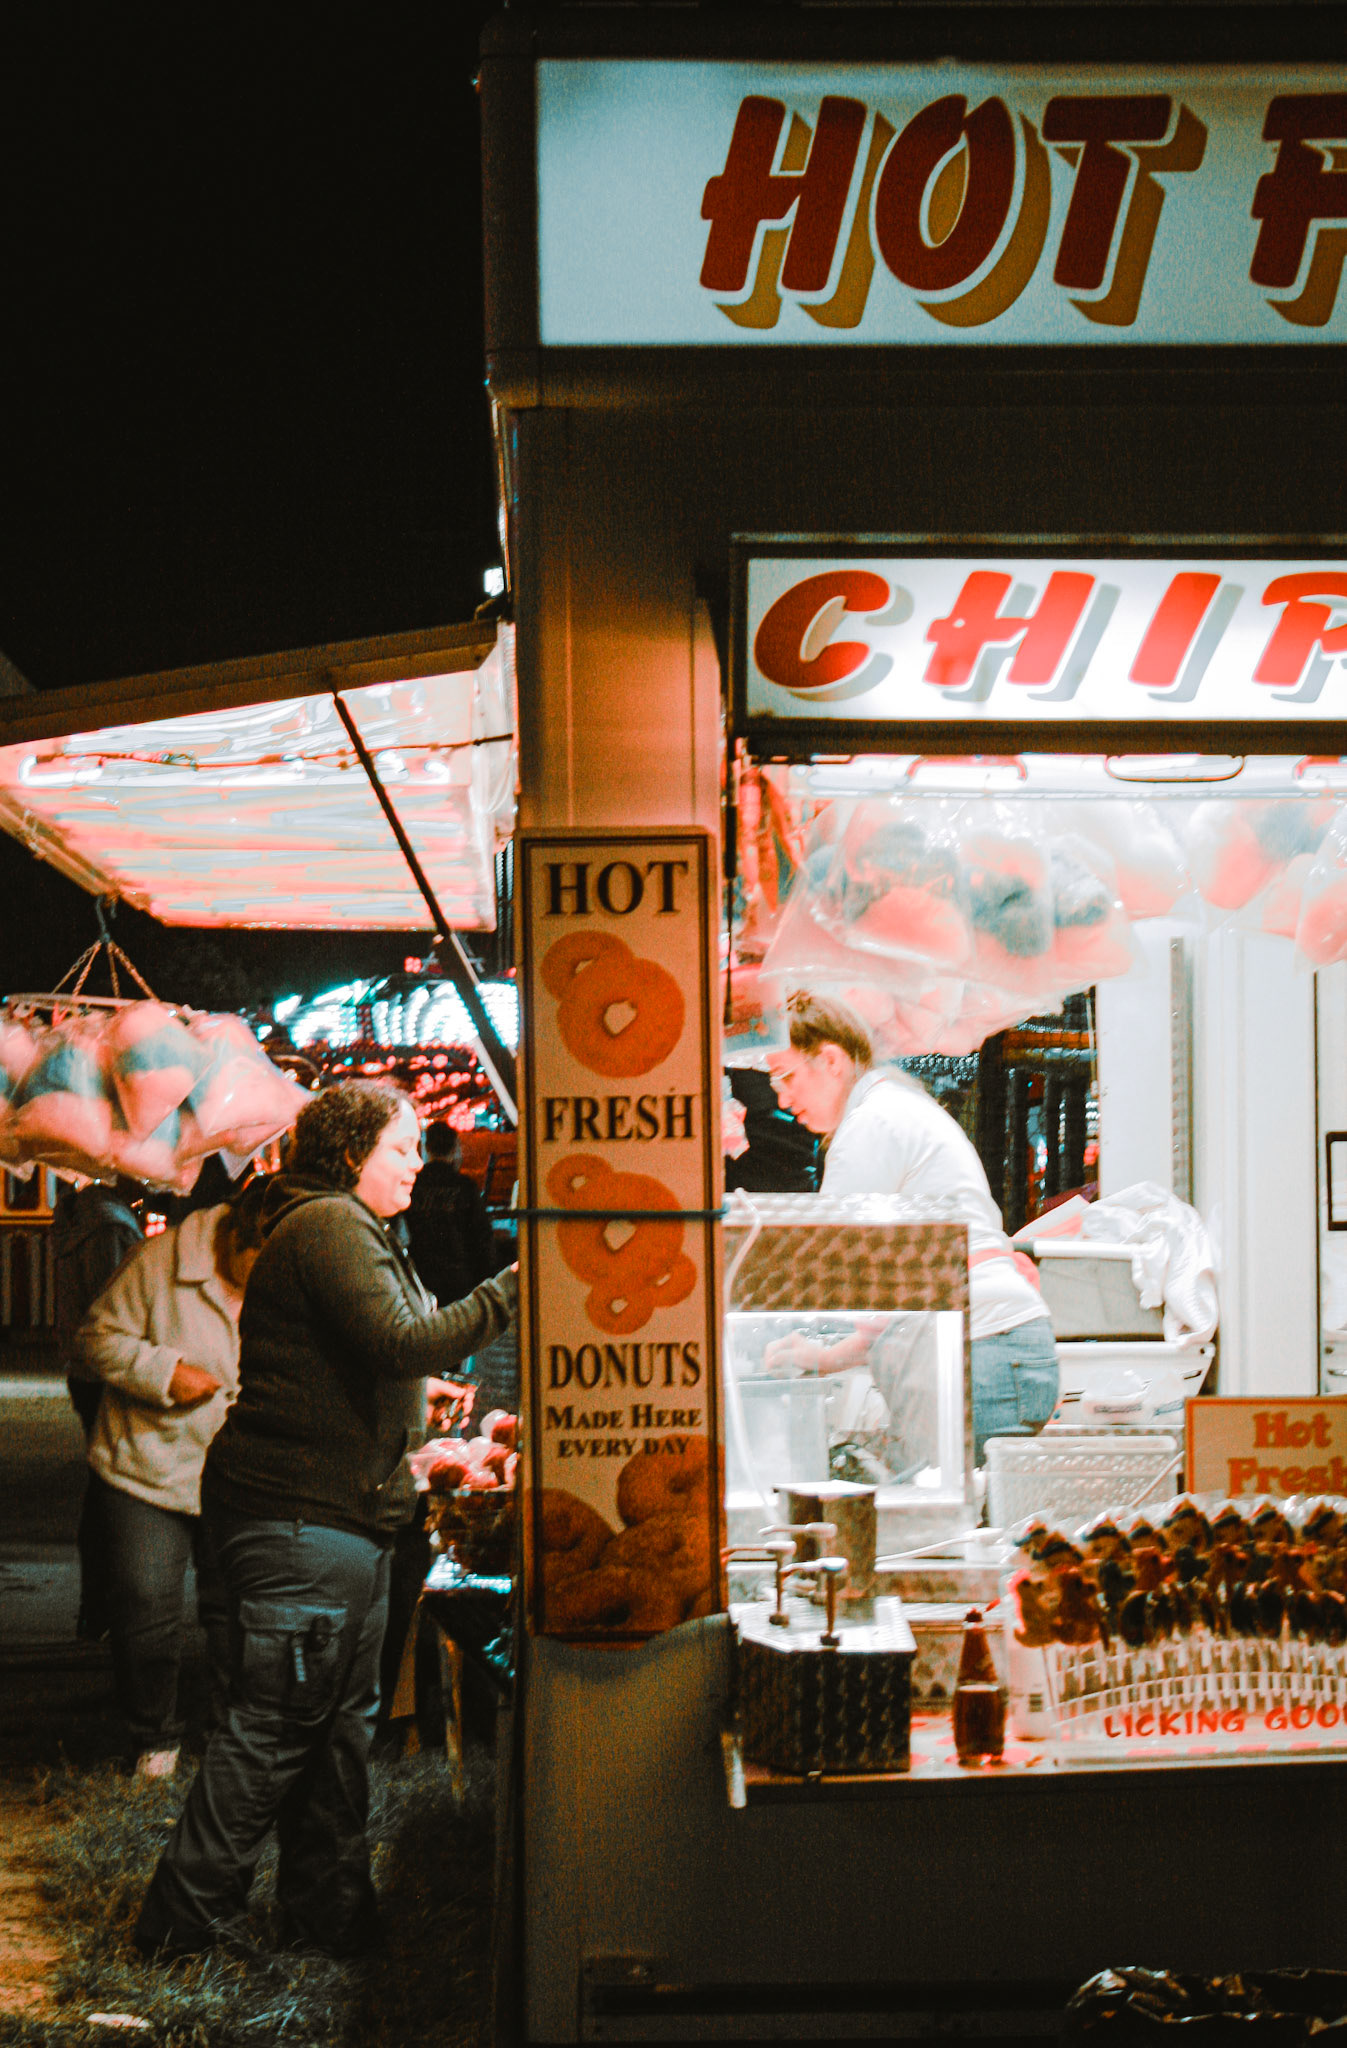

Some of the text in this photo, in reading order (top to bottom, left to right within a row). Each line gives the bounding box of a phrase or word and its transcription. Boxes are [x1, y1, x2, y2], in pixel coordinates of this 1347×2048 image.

[700, 93, 1200, 322] HOT
[544, 861, 689, 916] HOT
[542, 1094, 698, 1141] FRESH
[549, 1341, 702, 1389] DONUTS
[557, 1436, 690, 1458] EVERY DAY
[1252, 1410, 1333, 1450] Hot
[1103, 1703, 1347, 1738] LICKING GOO
